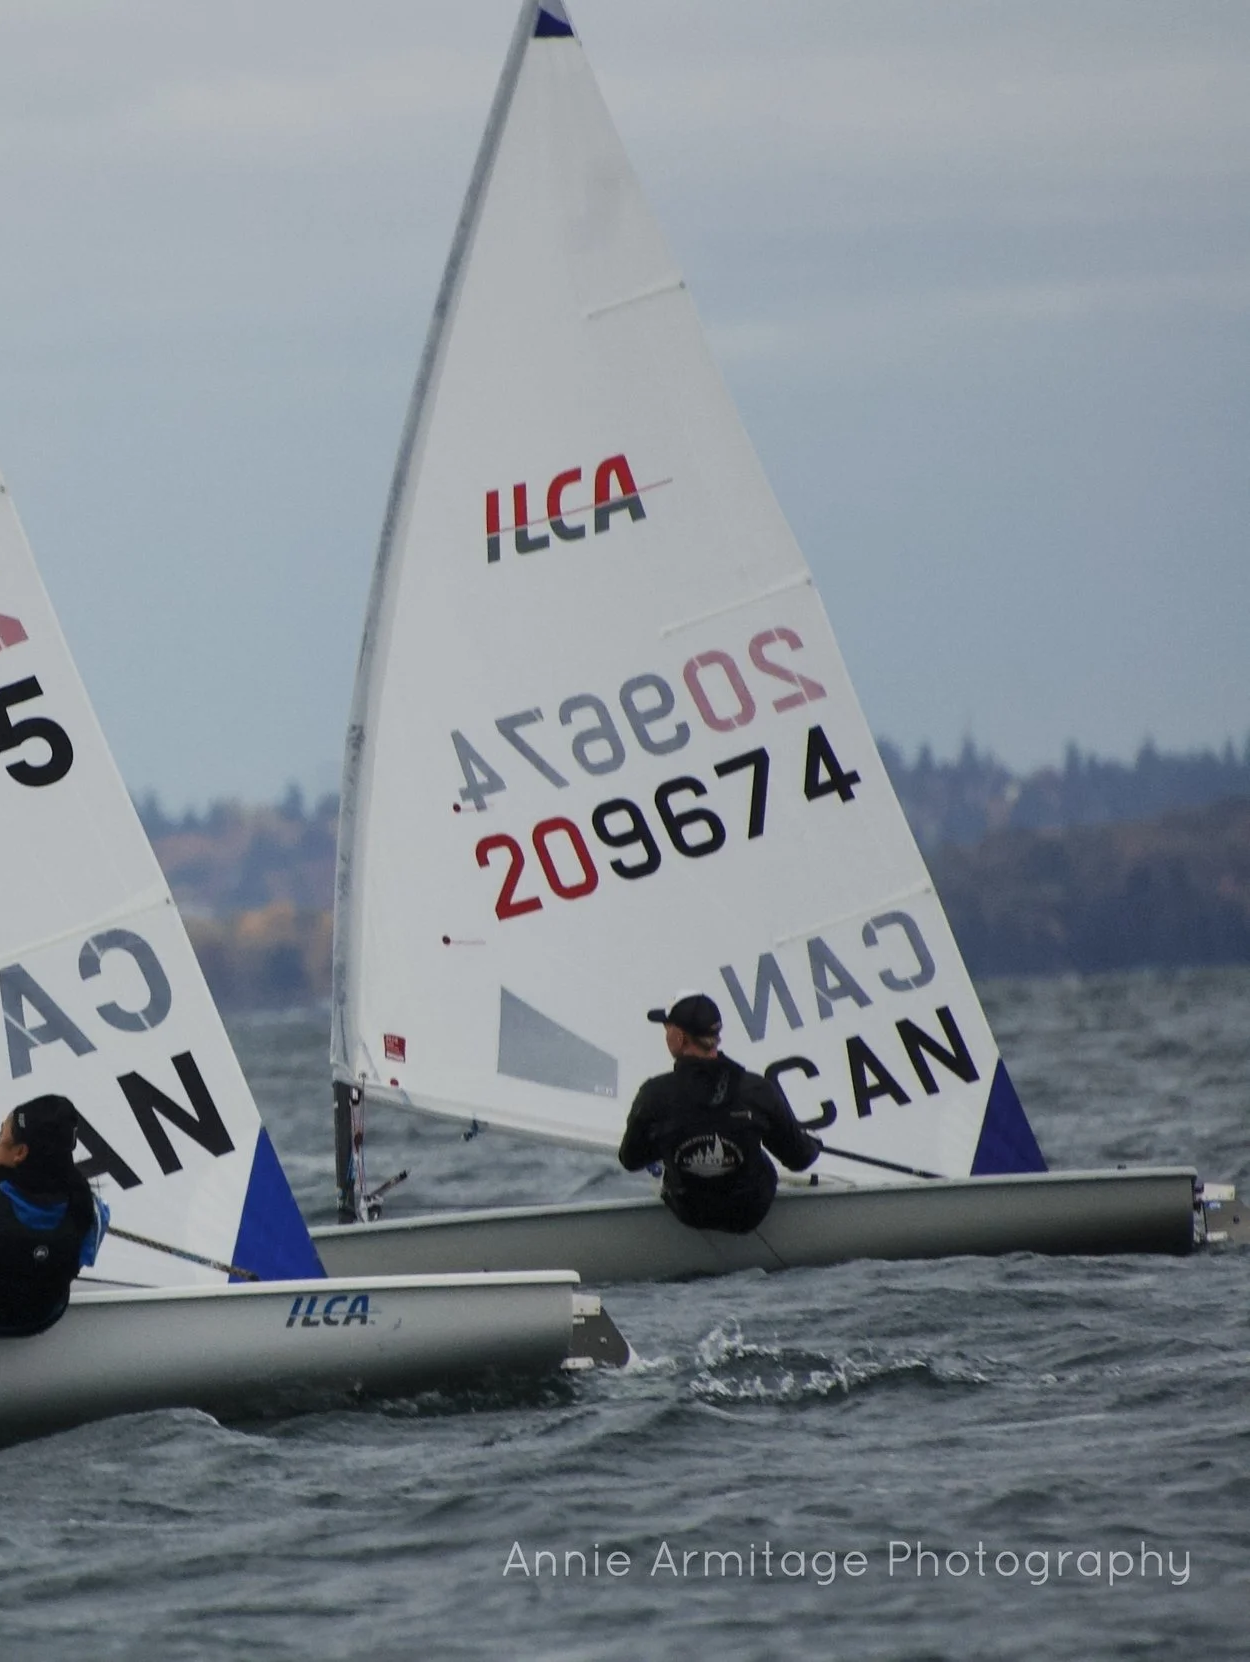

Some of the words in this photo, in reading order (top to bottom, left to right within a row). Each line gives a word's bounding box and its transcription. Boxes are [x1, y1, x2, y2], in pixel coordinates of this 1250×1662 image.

[485, 453, 646, 563] ILCA
[474, 725, 862, 921] 209674
[764, 1005, 980, 1131] CAN
[286, 1295, 371, 1328] ILCA
